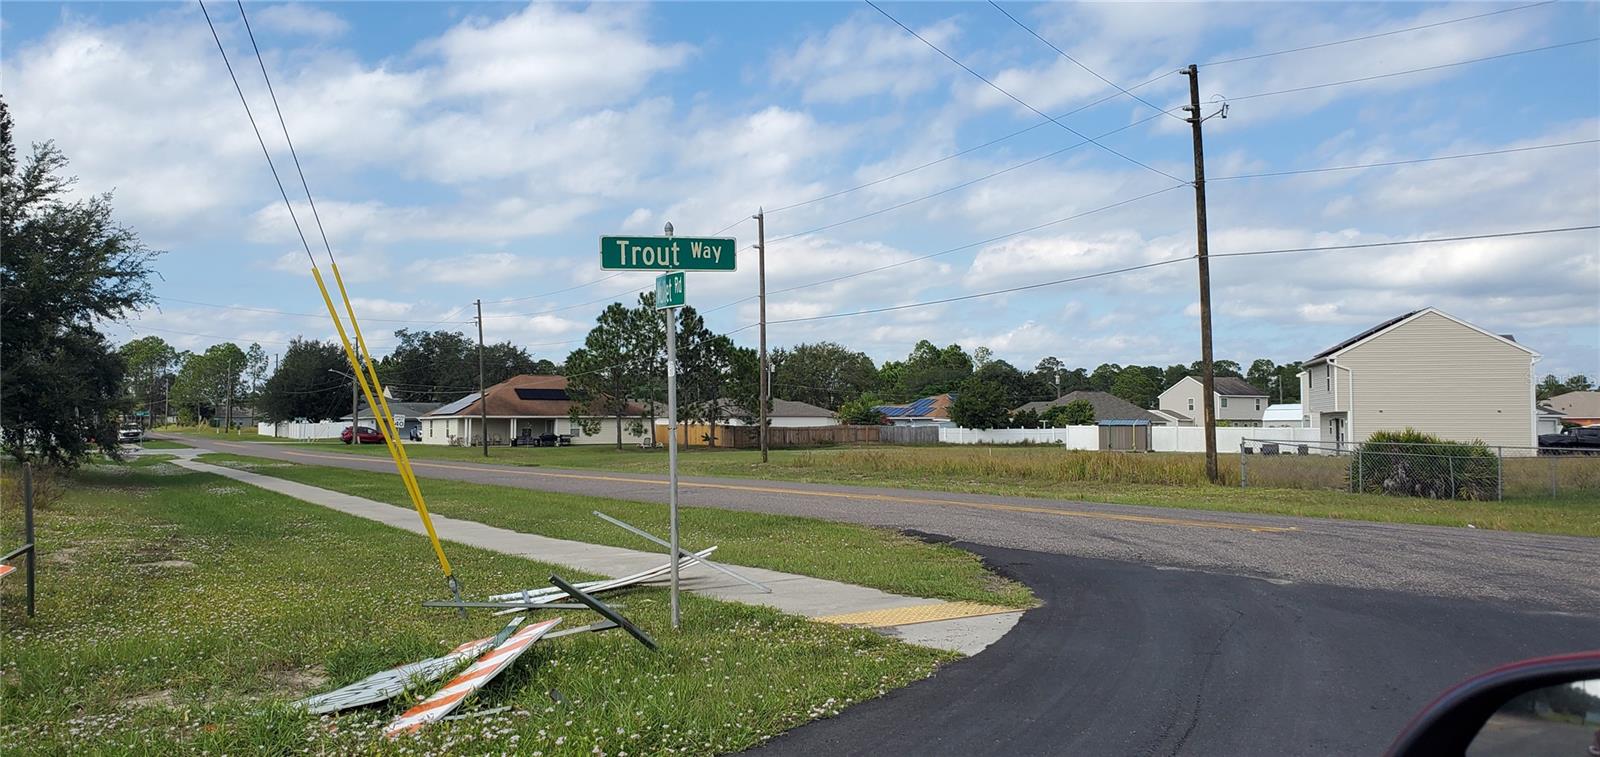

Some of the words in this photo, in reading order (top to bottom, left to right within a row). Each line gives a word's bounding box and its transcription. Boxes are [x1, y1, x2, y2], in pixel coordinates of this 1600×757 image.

[616, 240, 680, 266] Trout
[690, 241, 722, 264] Way
[674, 276, 683, 294] Rd
